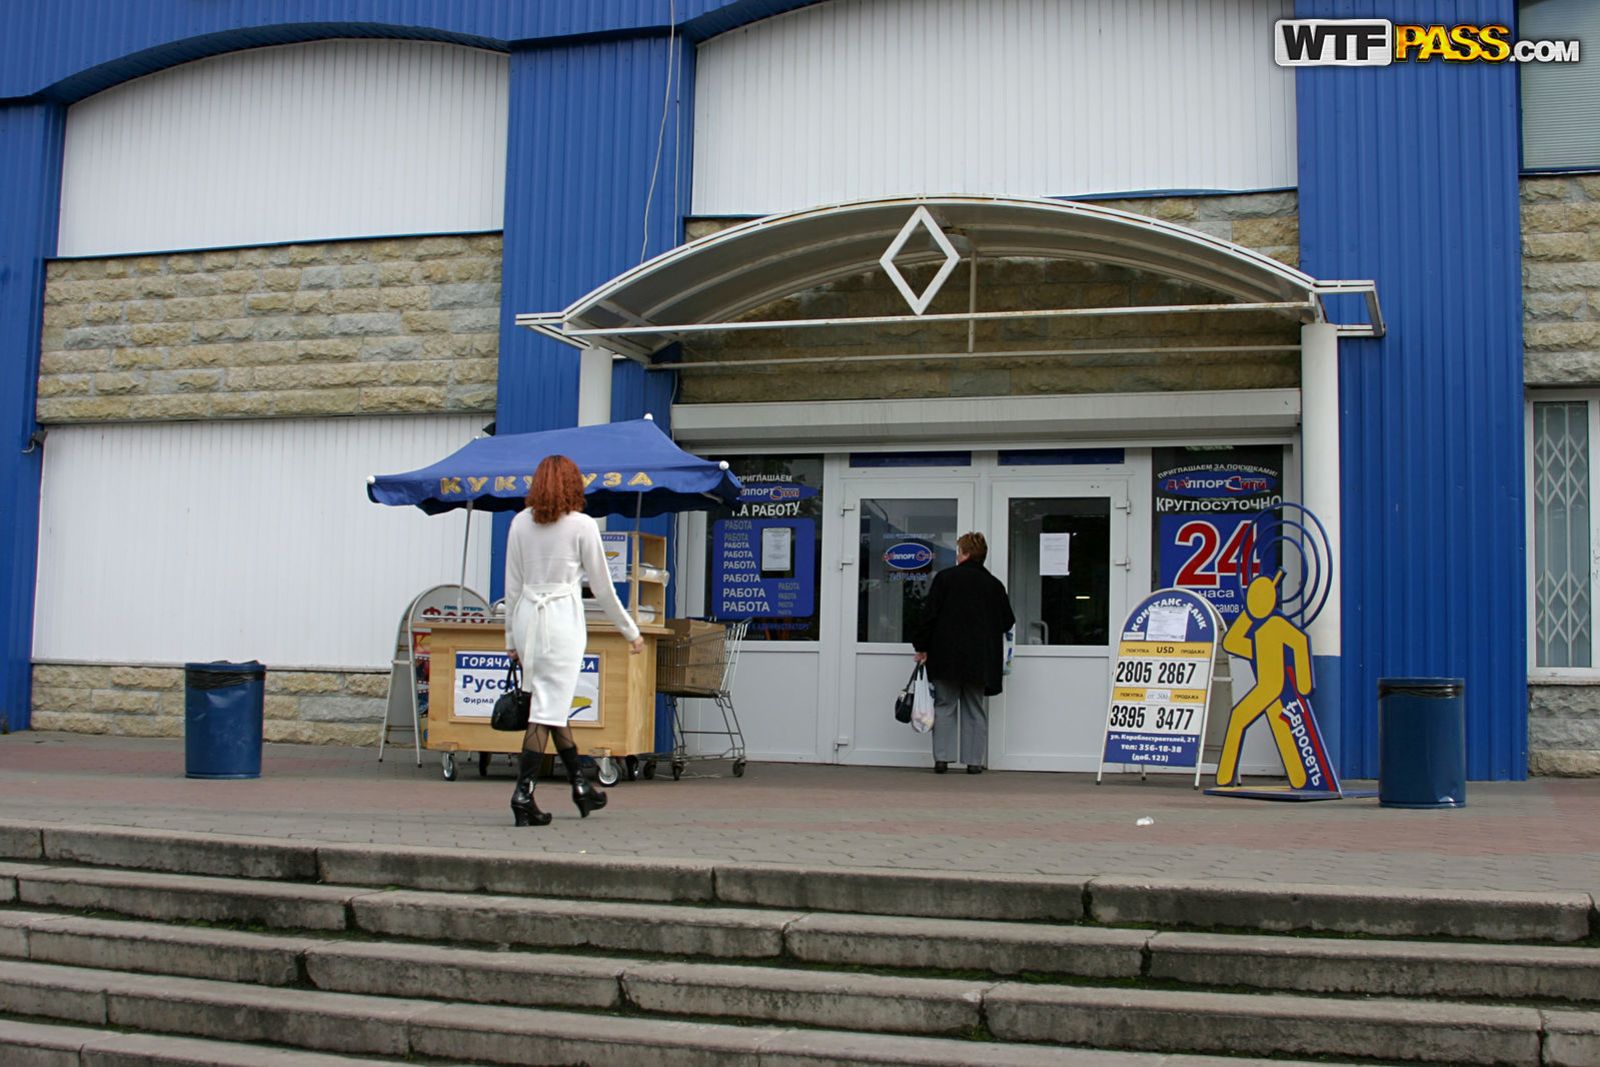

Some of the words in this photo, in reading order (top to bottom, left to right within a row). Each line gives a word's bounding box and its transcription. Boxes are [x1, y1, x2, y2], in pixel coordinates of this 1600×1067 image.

[1157, 464, 1212, 479] ПРИГЛАШАЕМ
[440, 472, 653, 495] КУКУЗА
[752, 501, 800, 516] РАБОТУ
[1156, 495, 1282, 511] КРУГЛОСУТОЧНО
[724, 521, 752, 530] РАБОТА
[1173, 520, 1261, 589] 24
[723, 561, 756, 569] РАБОТА
[723, 574, 761, 583] РАБОТА
[723, 588, 766, 598] РАБОТА
[723, 601, 770, 612] РАБОТА
[462, 656, 519, 668] ГОРЯЧА
[1115, 661, 1153, 684] 2805
[1157, 662, 1197, 684] 2867
[1110, 705, 1146, 729] 3395
[1156, 707, 1194, 730] 3477
[1139, 744, 1182, 753] 356-18-38
[1282, 698, 1322, 787] Евросеть
